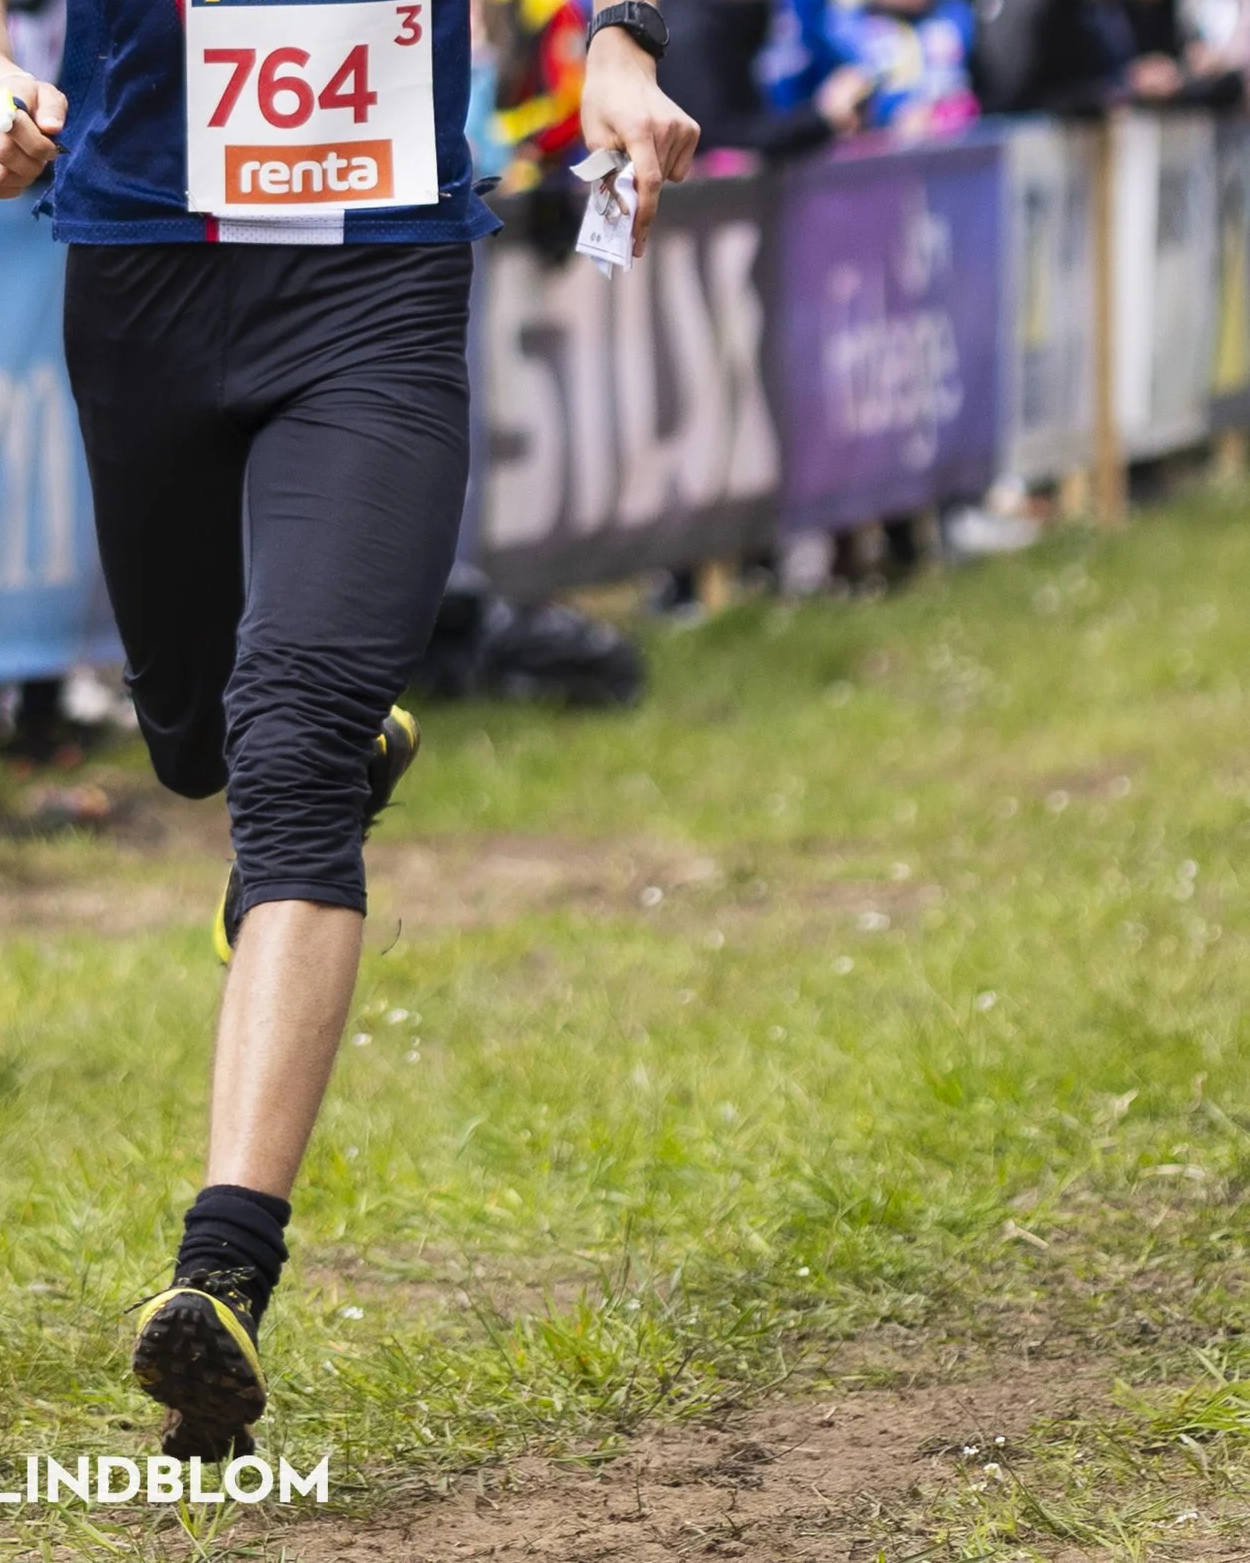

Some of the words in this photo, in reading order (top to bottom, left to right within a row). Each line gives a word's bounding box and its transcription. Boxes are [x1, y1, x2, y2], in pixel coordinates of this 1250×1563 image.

[393, 4, 423, 47] 3
[203, 44, 378, 130] 764
[239, 151, 379, 196] renta
